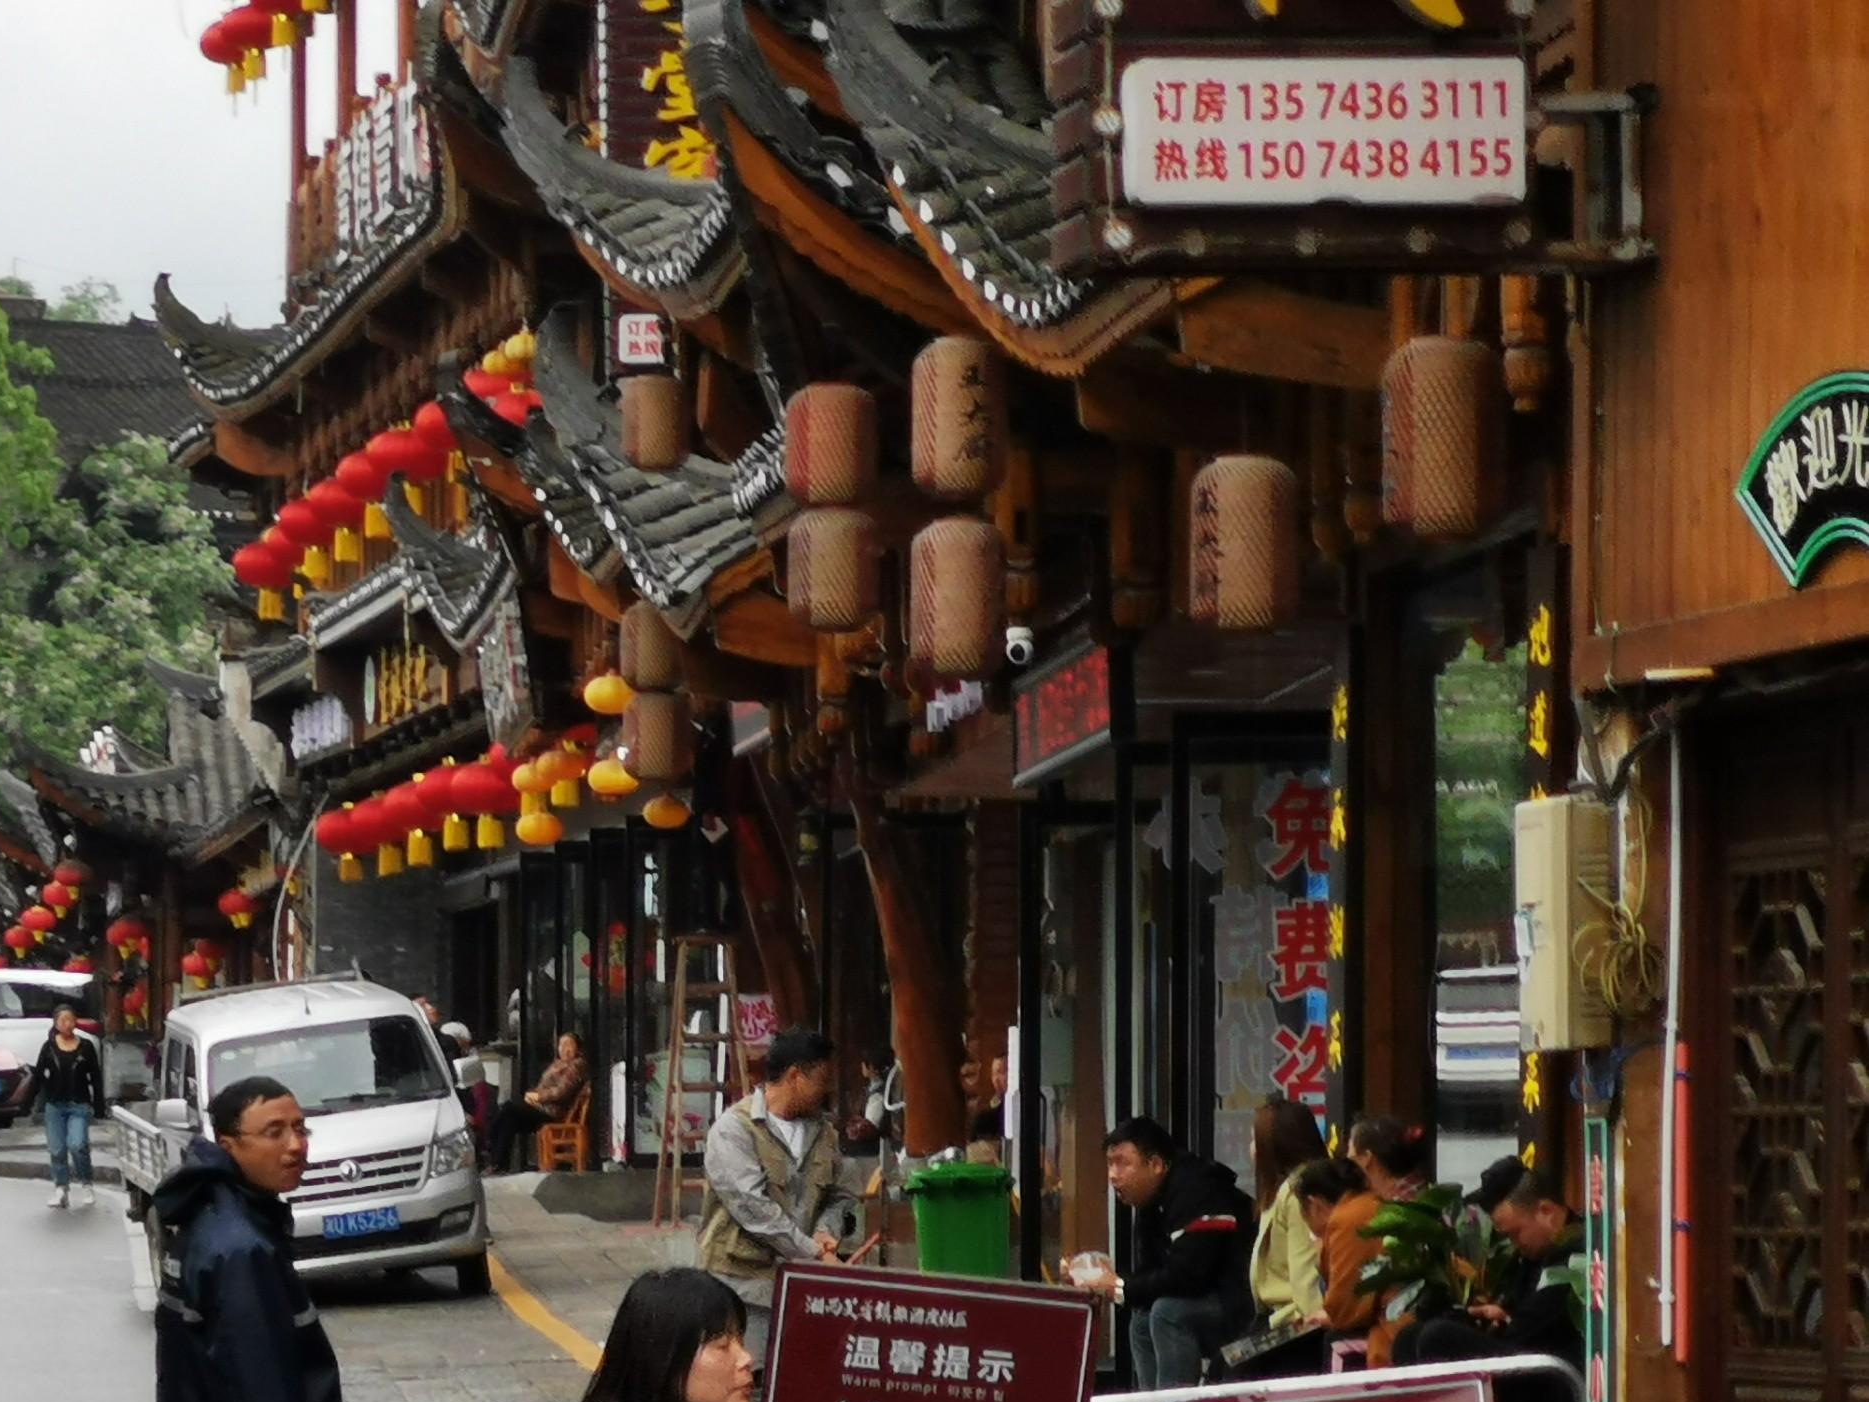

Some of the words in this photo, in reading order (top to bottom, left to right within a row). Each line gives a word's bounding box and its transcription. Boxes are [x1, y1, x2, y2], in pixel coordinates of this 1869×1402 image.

[1154, 80, 1226, 123] 订房
[1238, 82, 1305, 121] 135
[1317, 82, 1408, 121] 7436
[1420, 81, 1508, 119] 3111
[1154, 139, 1227, 181] 热线
[1239, 141, 1305, 179] 150
[1317, 139, 1409, 178] 7438
[1420, 139, 1513, 177] 4155
[844, 1334, 1015, 1383] 温馨提示
[841, 1373, 881, 1388] Warm
[886, 1377, 938, 1396] prompt
